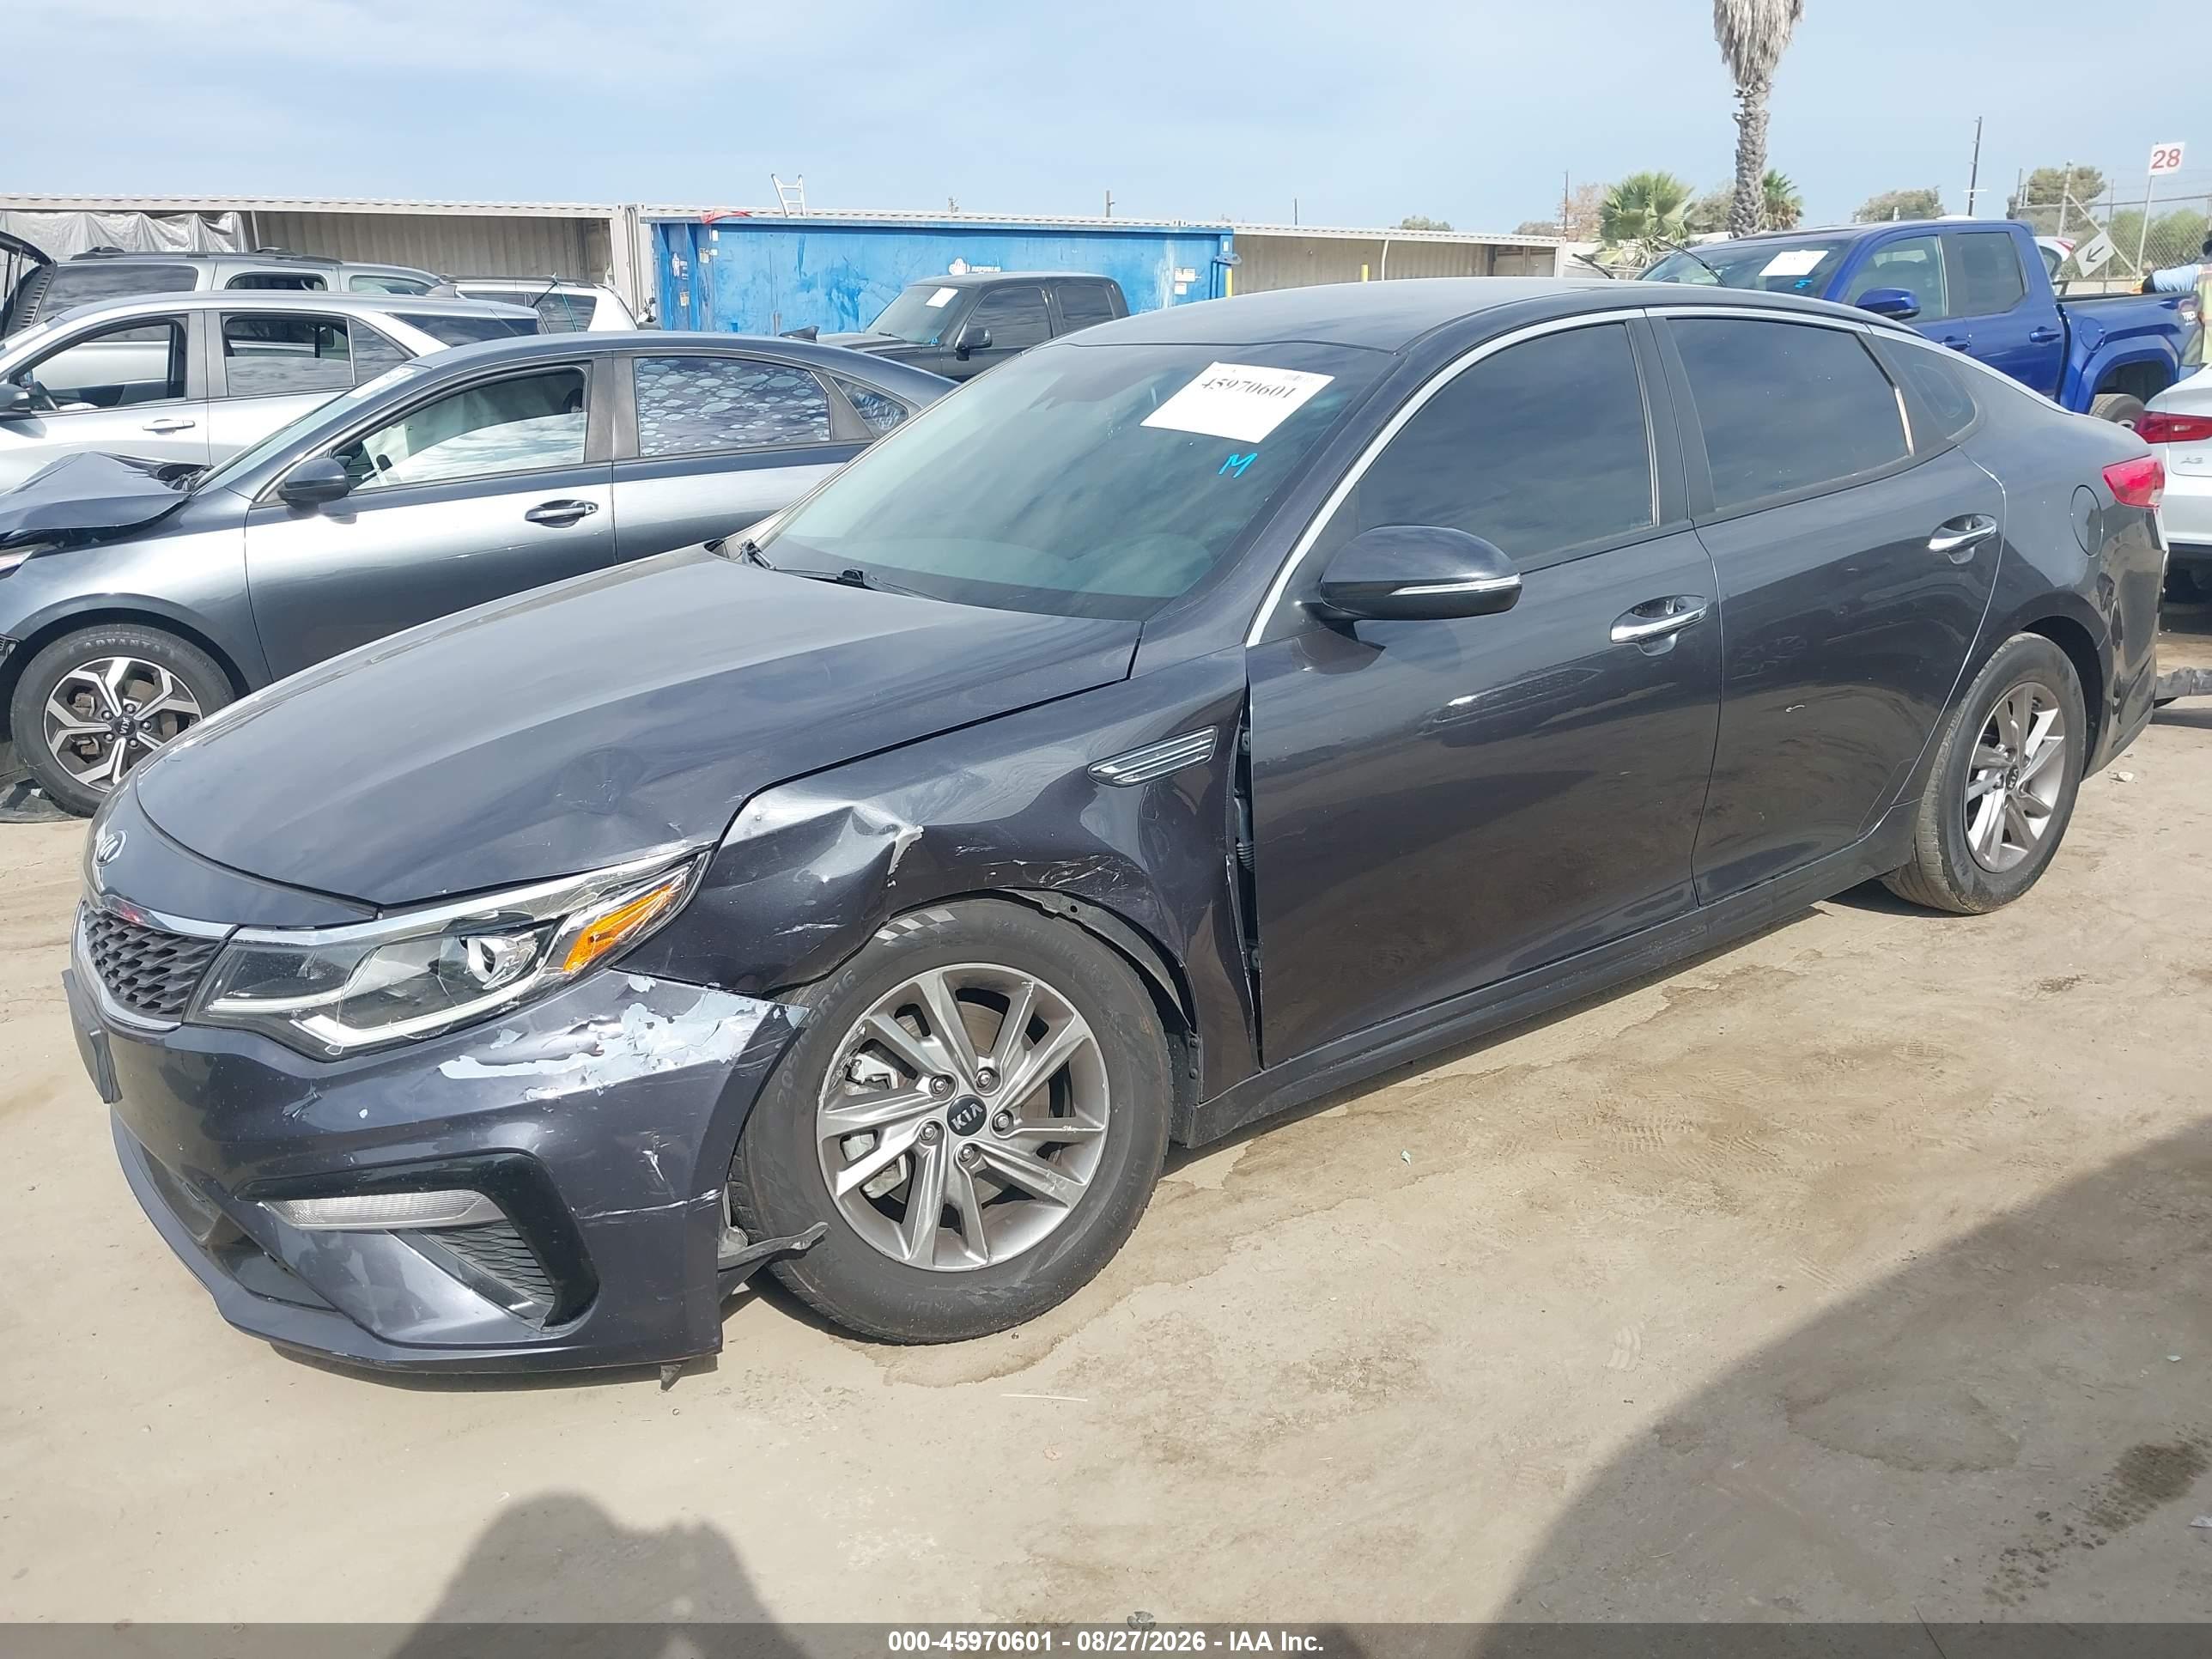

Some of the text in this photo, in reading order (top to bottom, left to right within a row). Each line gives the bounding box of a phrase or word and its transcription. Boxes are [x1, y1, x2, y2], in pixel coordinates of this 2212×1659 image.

[2151, 148, 2181, 170] 28
[1218, 453, 1258, 478] M
[951, 1103, 983, 1130] KIA
